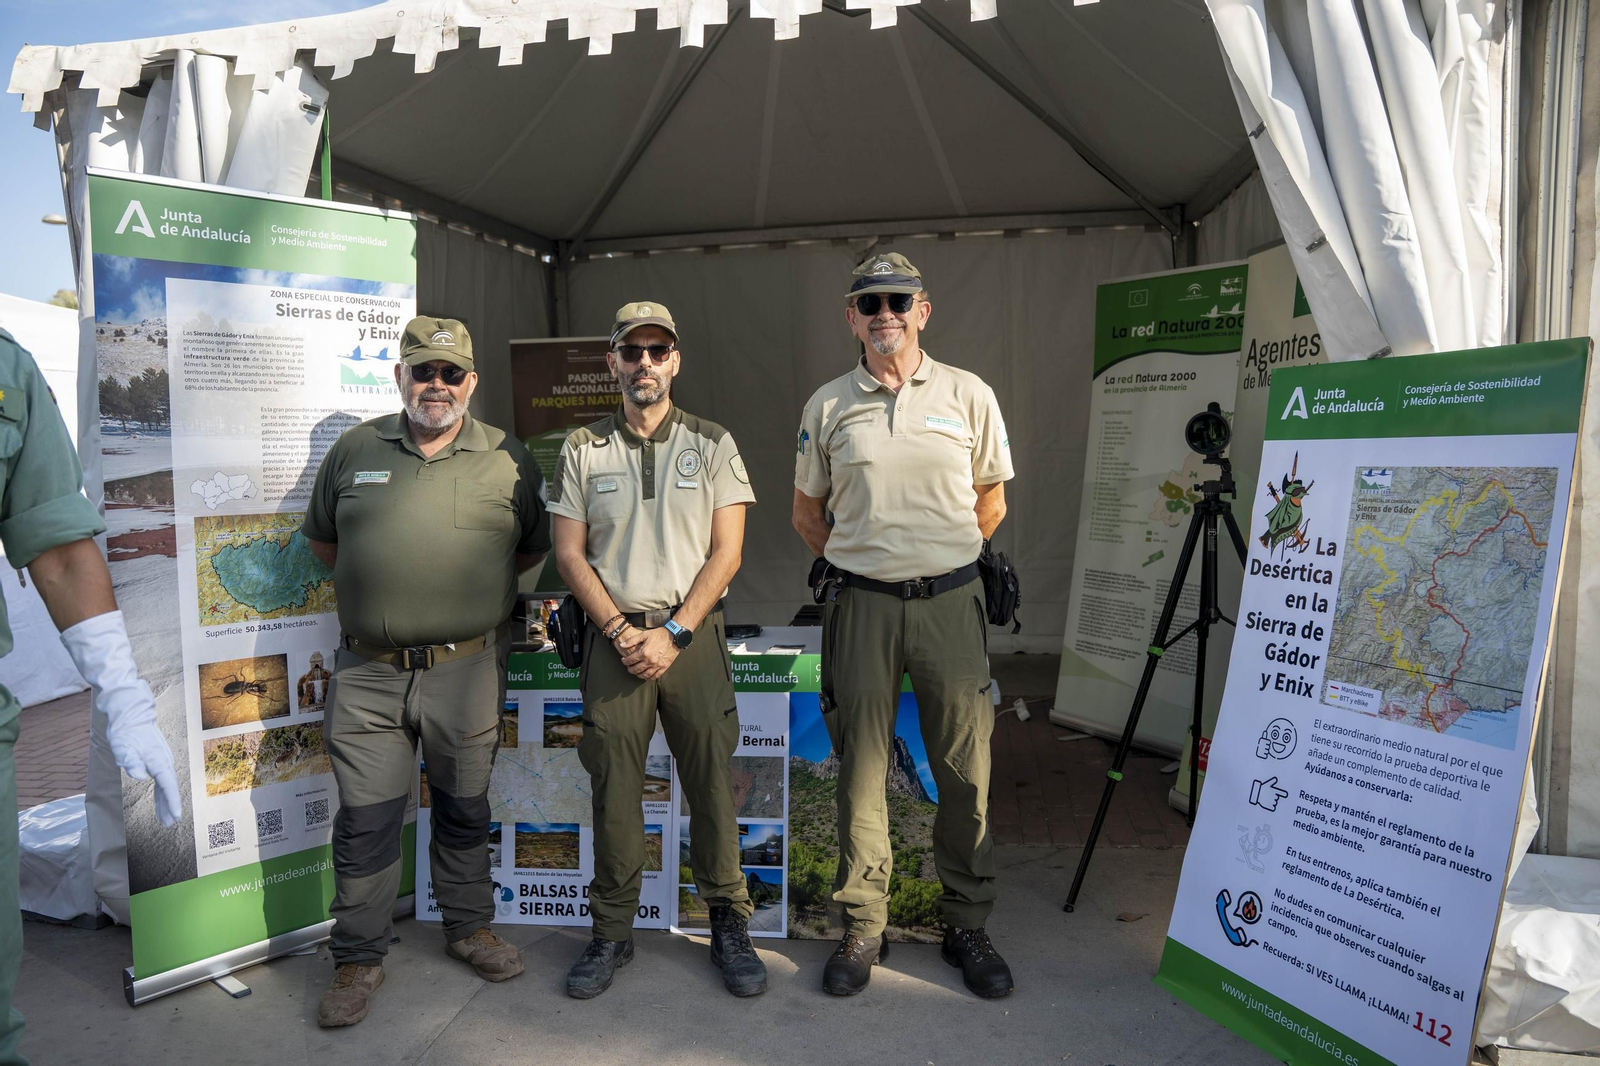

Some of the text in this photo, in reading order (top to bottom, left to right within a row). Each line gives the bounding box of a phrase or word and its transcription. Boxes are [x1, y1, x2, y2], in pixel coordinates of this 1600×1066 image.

[160, 208, 202, 224] Junta
[160, 222, 251, 244] de Andalucía
[271, 225, 387, 247] Consejería de Sostenibilidad
[271, 236, 347, 252] y Medio Ambiente
[271, 290, 293, 299] ZONA
[295, 293, 332, 302] ESPECIAL
[346, 297, 401, 308] CONSERVACIÓN
[276, 303, 400, 325] Sierras de Gádor
[359, 327, 400, 341] y Enix
[1112, 320, 1210, 340] La red Natura
[1245, 333, 1321, 373] Agentes
[1105, 372, 1197, 385] La red Natura 2000
[1243, 373, 1256, 390] de
[1405, 376, 1542, 396] Consejería de Sostenibilidad
[341, 386, 380, 395] NATURA
[552, 383, 623, 396] NACIONALES
[1120, 385, 1148, 395] provincia
[1159, 384, 1187, 392] Almería
[1314, 388, 1346, 400] Junta
[532, 396, 587, 409] PARQUES
[1312, 398, 1384, 415] de Andalucía
[1403, 394, 1485, 409] y Medio Ambiente
[1355, 513, 1377, 522] y Enix
[1356, 503, 1417, 515] Sierras de Gádor
[1316, 537, 1337, 557] La
[1250, 559, 1333, 585] Desértica
[1285, 593, 1328, 614] en la
[206, 620, 319, 639] Superficie 50.343,58 hectáreas.
[1246, 612, 1324, 642] Sierra de
[1265, 643, 1321, 670] Gádor
[554, 671, 577, 679] Medio
[743, 671, 801, 684] Andalucía
[1259, 673, 1315, 699] y Enix
[1341, 686, 1374, 699] Marchadores
[743, 735, 785, 747] Bernal
[1314, 719, 1503, 778] El extraordinario medio natural por el que
[1311, 734, 1491, 792] tiene su recorrido la prueba deportiva le
[1305, 762, 1347, 782] Ayúdanos
[1355, 779, 1413, 803] conservarla:
[1308, 748, 1462, 802] añade un complemento de calidad.
[1299, 790, 1475, 858] Respeta y mantén el reglamento de la
[1293, 820, 1365, 853] medio ambiente.
[1296, 806, 1492, 882] prueba, es la mejor garantía para nuestro
[220, 857, 335, 898] www.juntadeandalu
[1286, 846, 1441, 917] En tus entrenos, aplica también el
[520, 884, 578, 899] BALSAS
[1282, 862, 1404, 920] reglamento de La Desértica.
[519, 902, 576, 917] SIERRA
[1268, 918, 1298, 938] campo.
[1274, 888, 1426, 964] No dudes en comunicar cualquier
[1271, 902, 1465, 1002] incidencia que observes cuando salgas al
[1263, 941, 1452, 1047] Recuerda: SI VES LLAMA ¡LLAMA! 112
[1222, 981, 1359, 1066] www.juntadeandalucia.es
